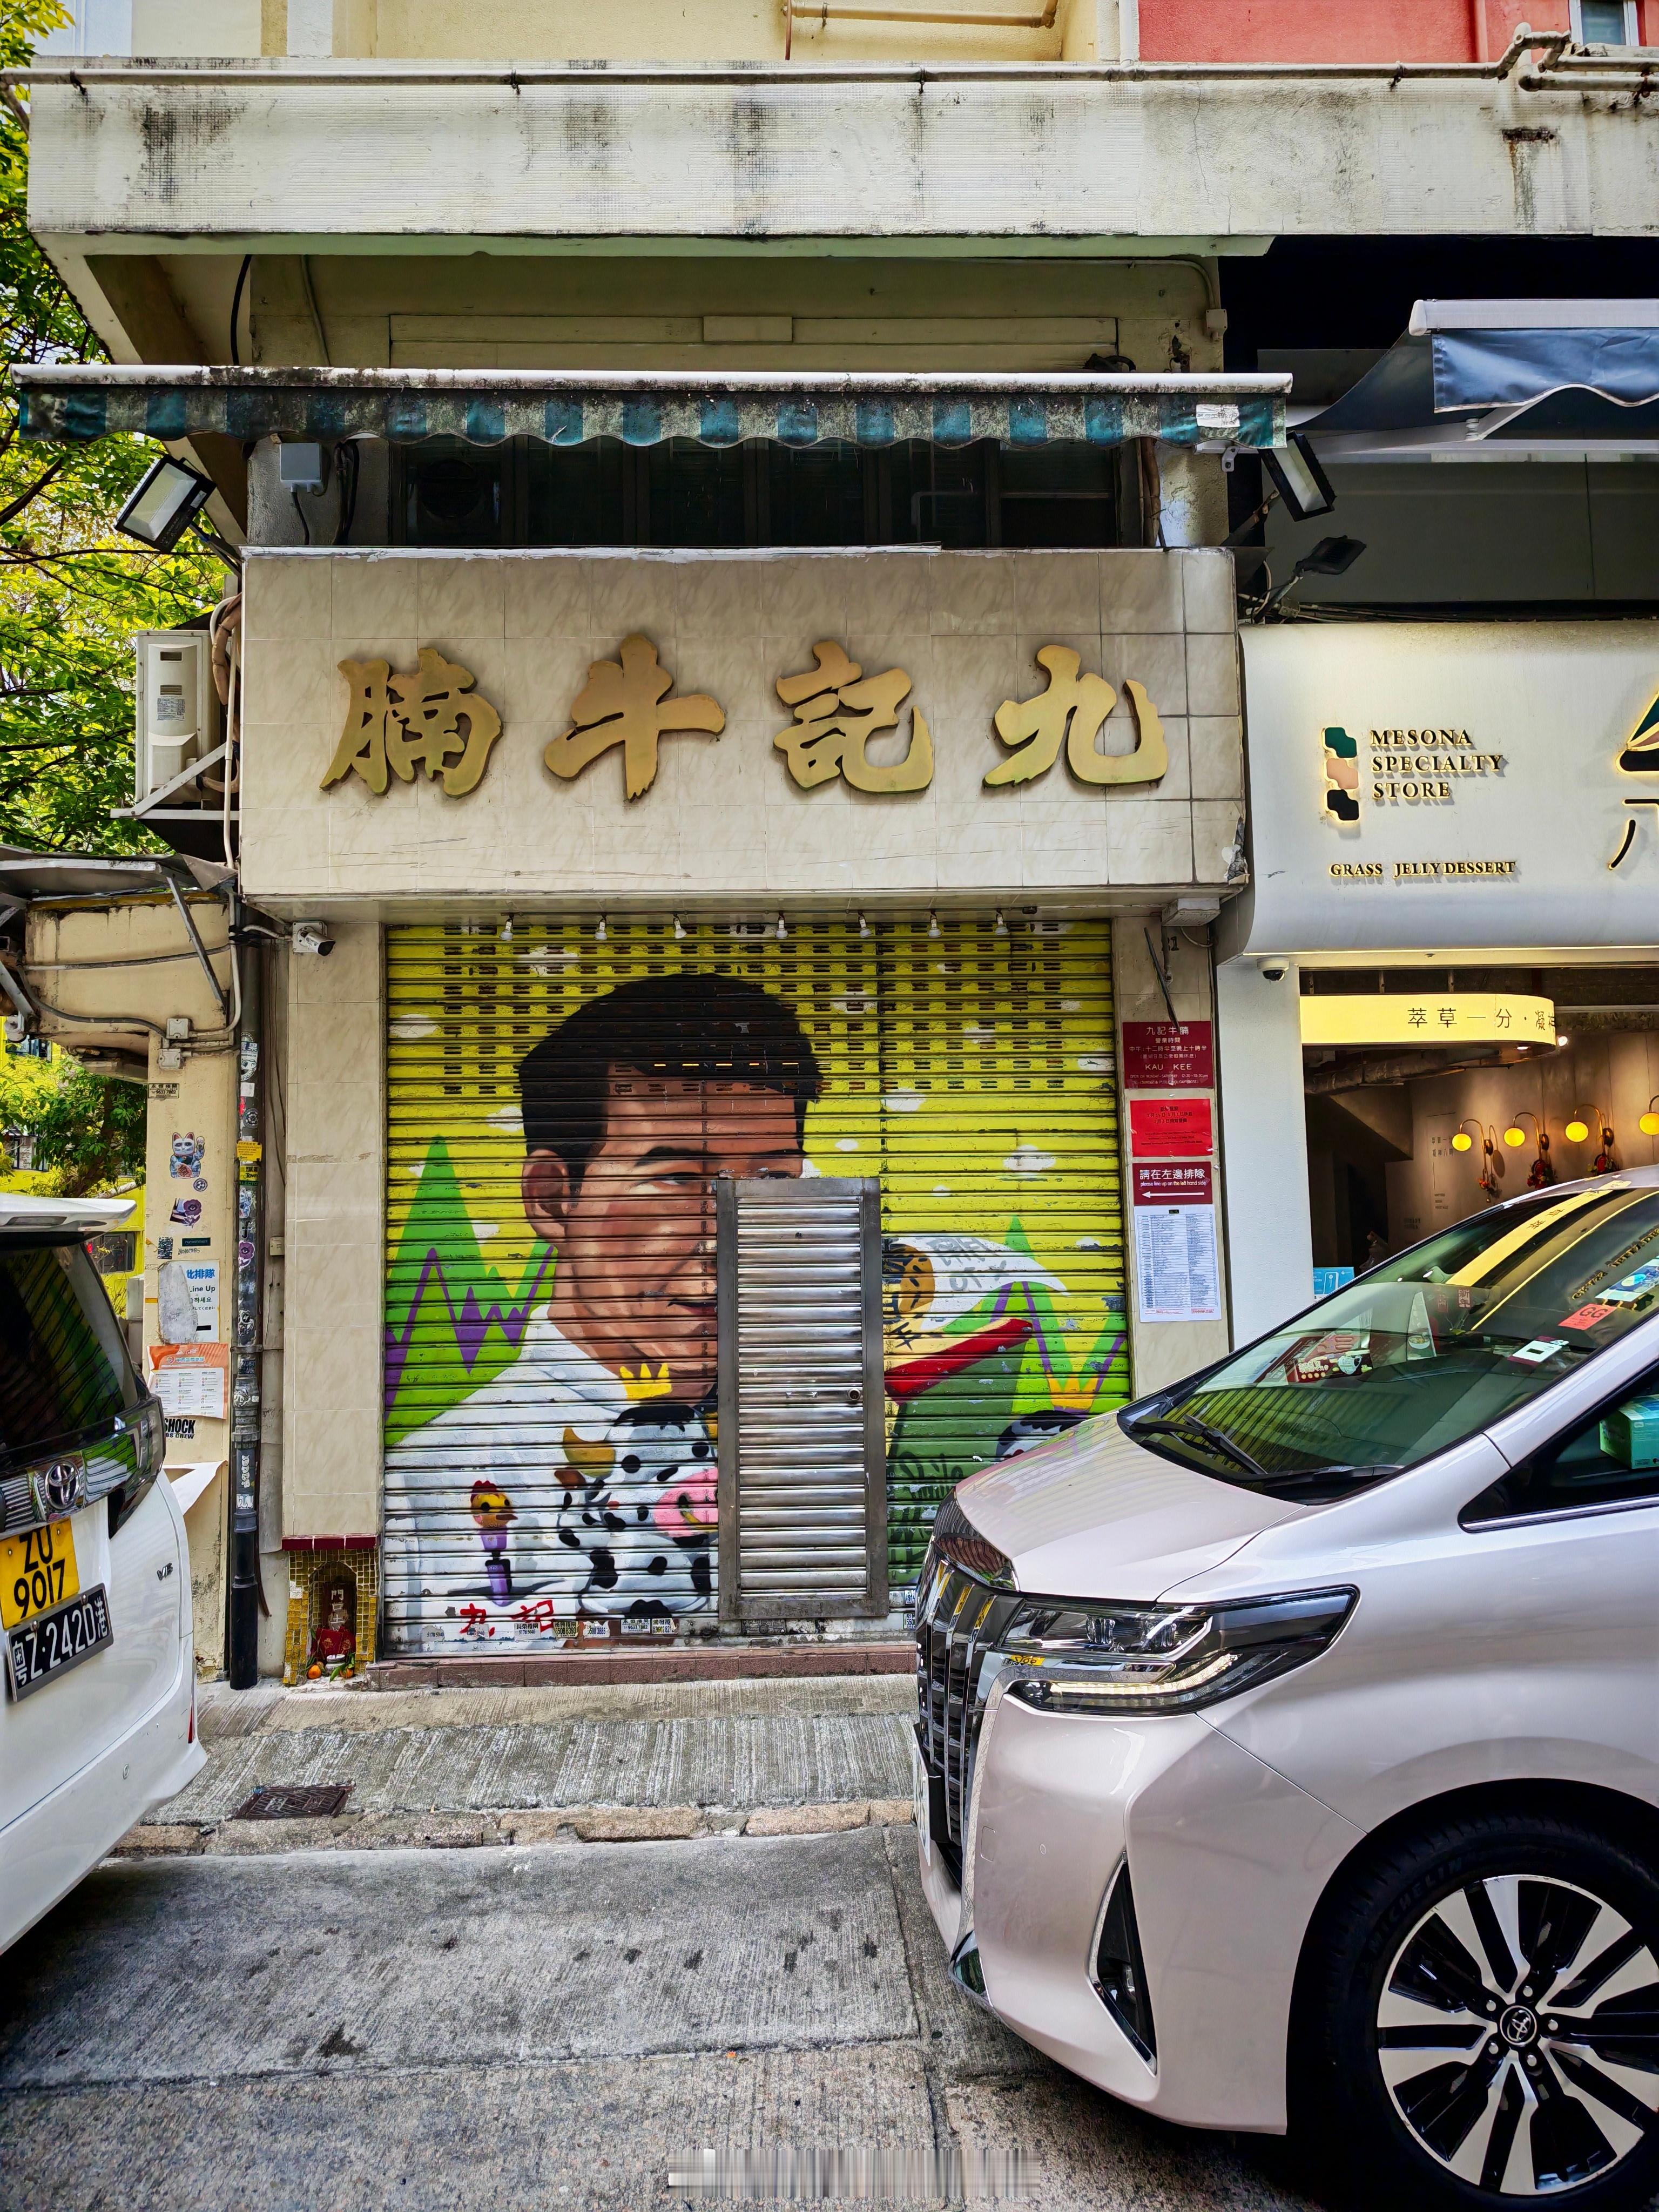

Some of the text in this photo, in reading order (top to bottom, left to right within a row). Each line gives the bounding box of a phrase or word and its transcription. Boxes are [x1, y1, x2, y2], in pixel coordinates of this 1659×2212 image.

[1371, 729, 1473, 746] MESONA
[1372, 755, 1503, 772] SPECIALTY
[1372, 781, 1451, 798] STORE
[1330, 861, 1516, 879] GRASS JELLY DESSERT
[1146, 1026, 1189, 1035] 九記牛腩
[1139, 1168, 1205, 1180] 請在左邊排隊
[19, 1525, 53, 1574] ZU
[14, 1559, 65, 1619] 9017
